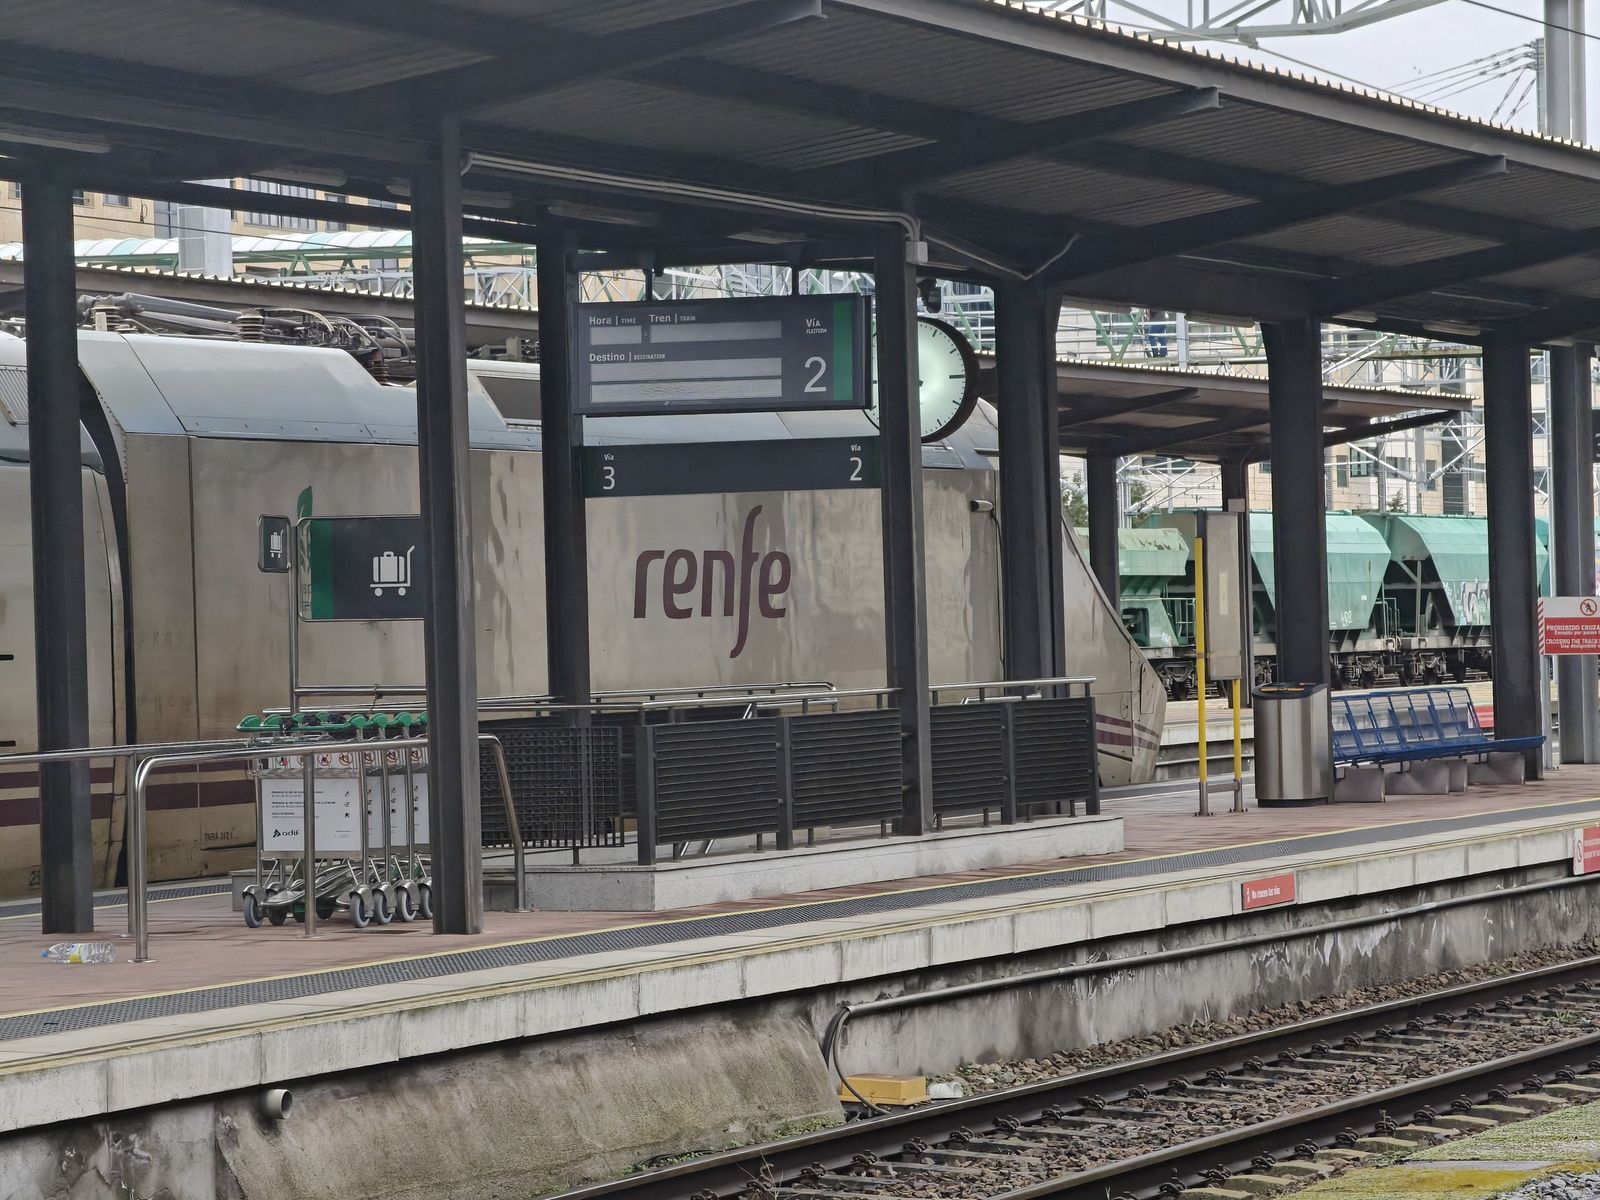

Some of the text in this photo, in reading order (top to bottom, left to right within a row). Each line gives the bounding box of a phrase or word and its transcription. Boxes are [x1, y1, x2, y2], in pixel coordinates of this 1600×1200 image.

[589, 316, 612, 325] Hora
[649, 314, 671, 323] Tren
[589, 352, 666, 362] Destino DESTINATION
[804, 356, 827, 393] 2
[603, 466, 616, 490] 3
[849, 456, 863, 481] 2
[633, 504, 791, 659] renfe
